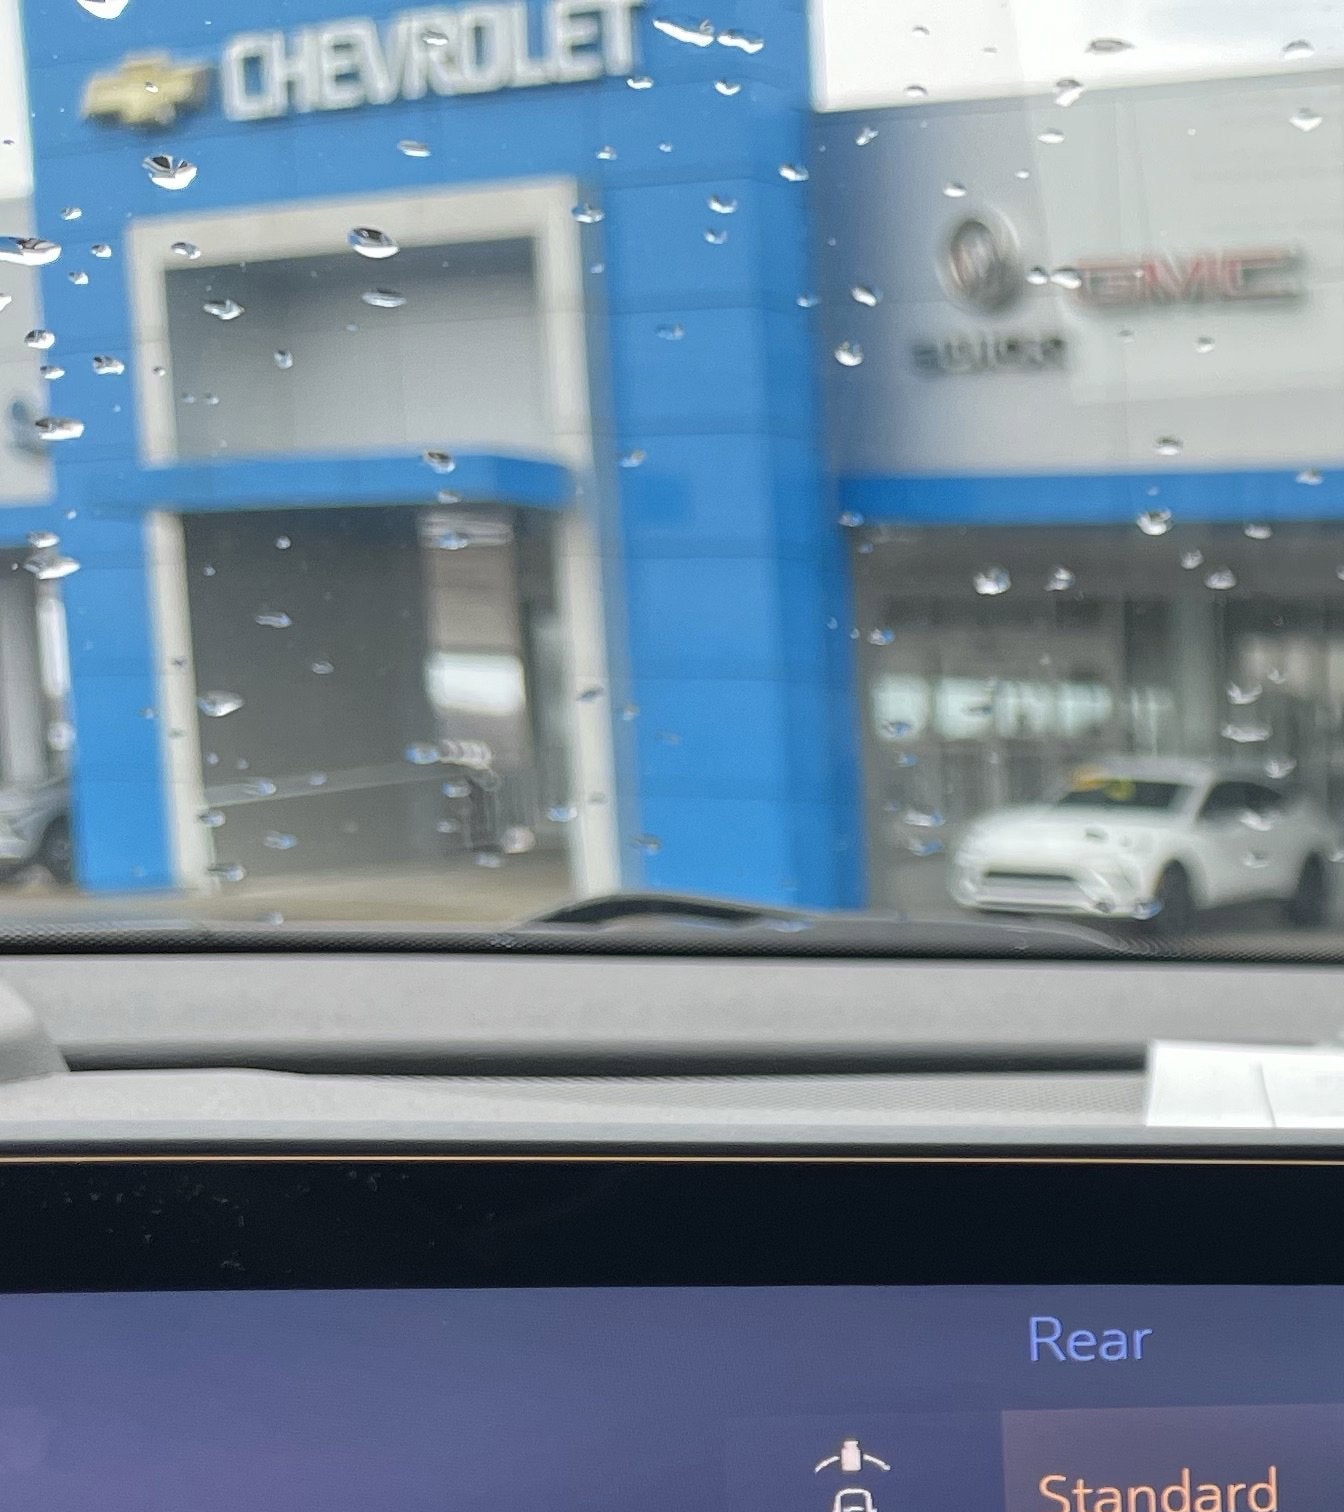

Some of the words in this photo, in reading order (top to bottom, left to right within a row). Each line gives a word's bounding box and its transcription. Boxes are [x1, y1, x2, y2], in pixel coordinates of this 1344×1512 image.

[220, 0, 644, 122] CHEVROLET
[1076, 246, 1306, 310] GMC
[1028, 1316, 1152, 1363] Rear
